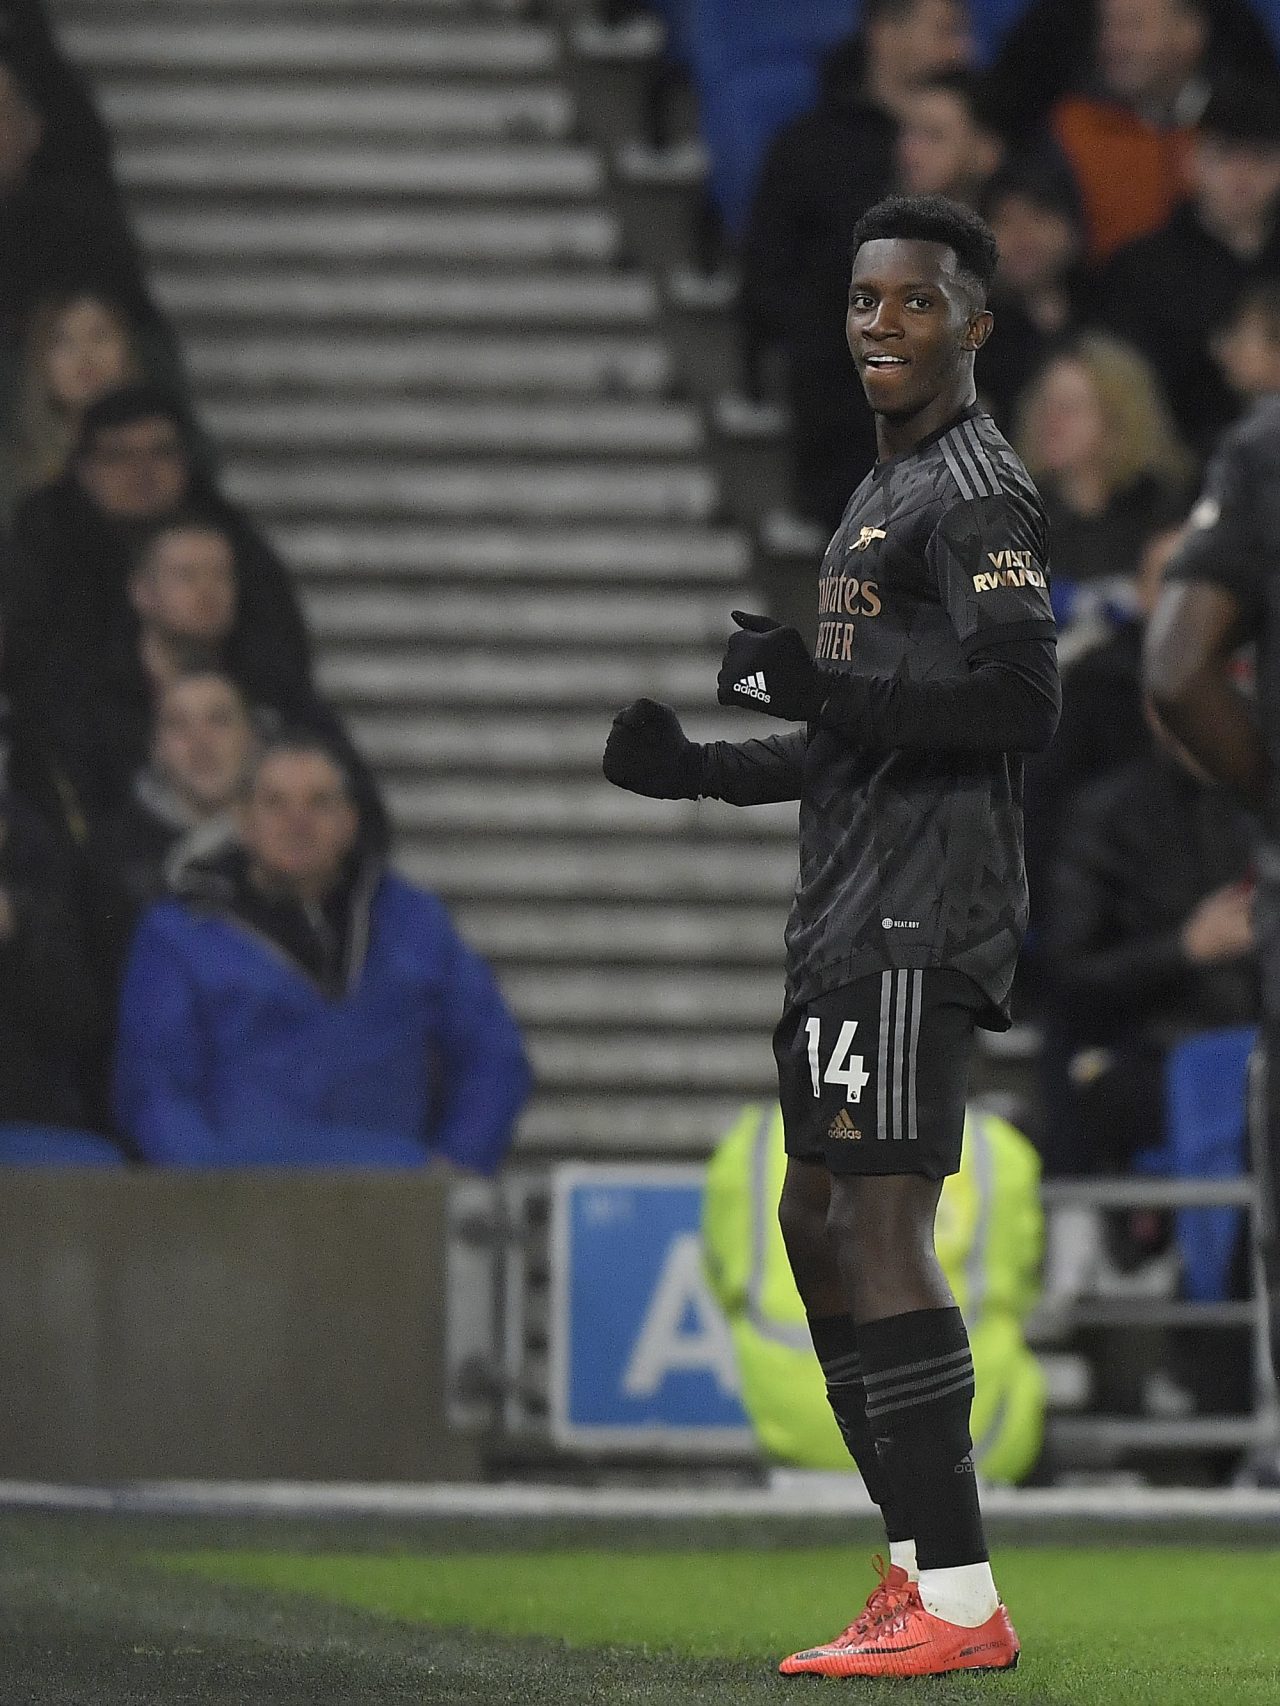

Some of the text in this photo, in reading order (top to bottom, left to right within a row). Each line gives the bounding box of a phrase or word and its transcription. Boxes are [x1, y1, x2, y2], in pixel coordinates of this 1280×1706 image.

[733, 683, 771, 704] adidas
[804, 1017, 870, 1103] 14
[827, 1127, 862, 1140] adidas
[622, 1230, 746, 1396] A
